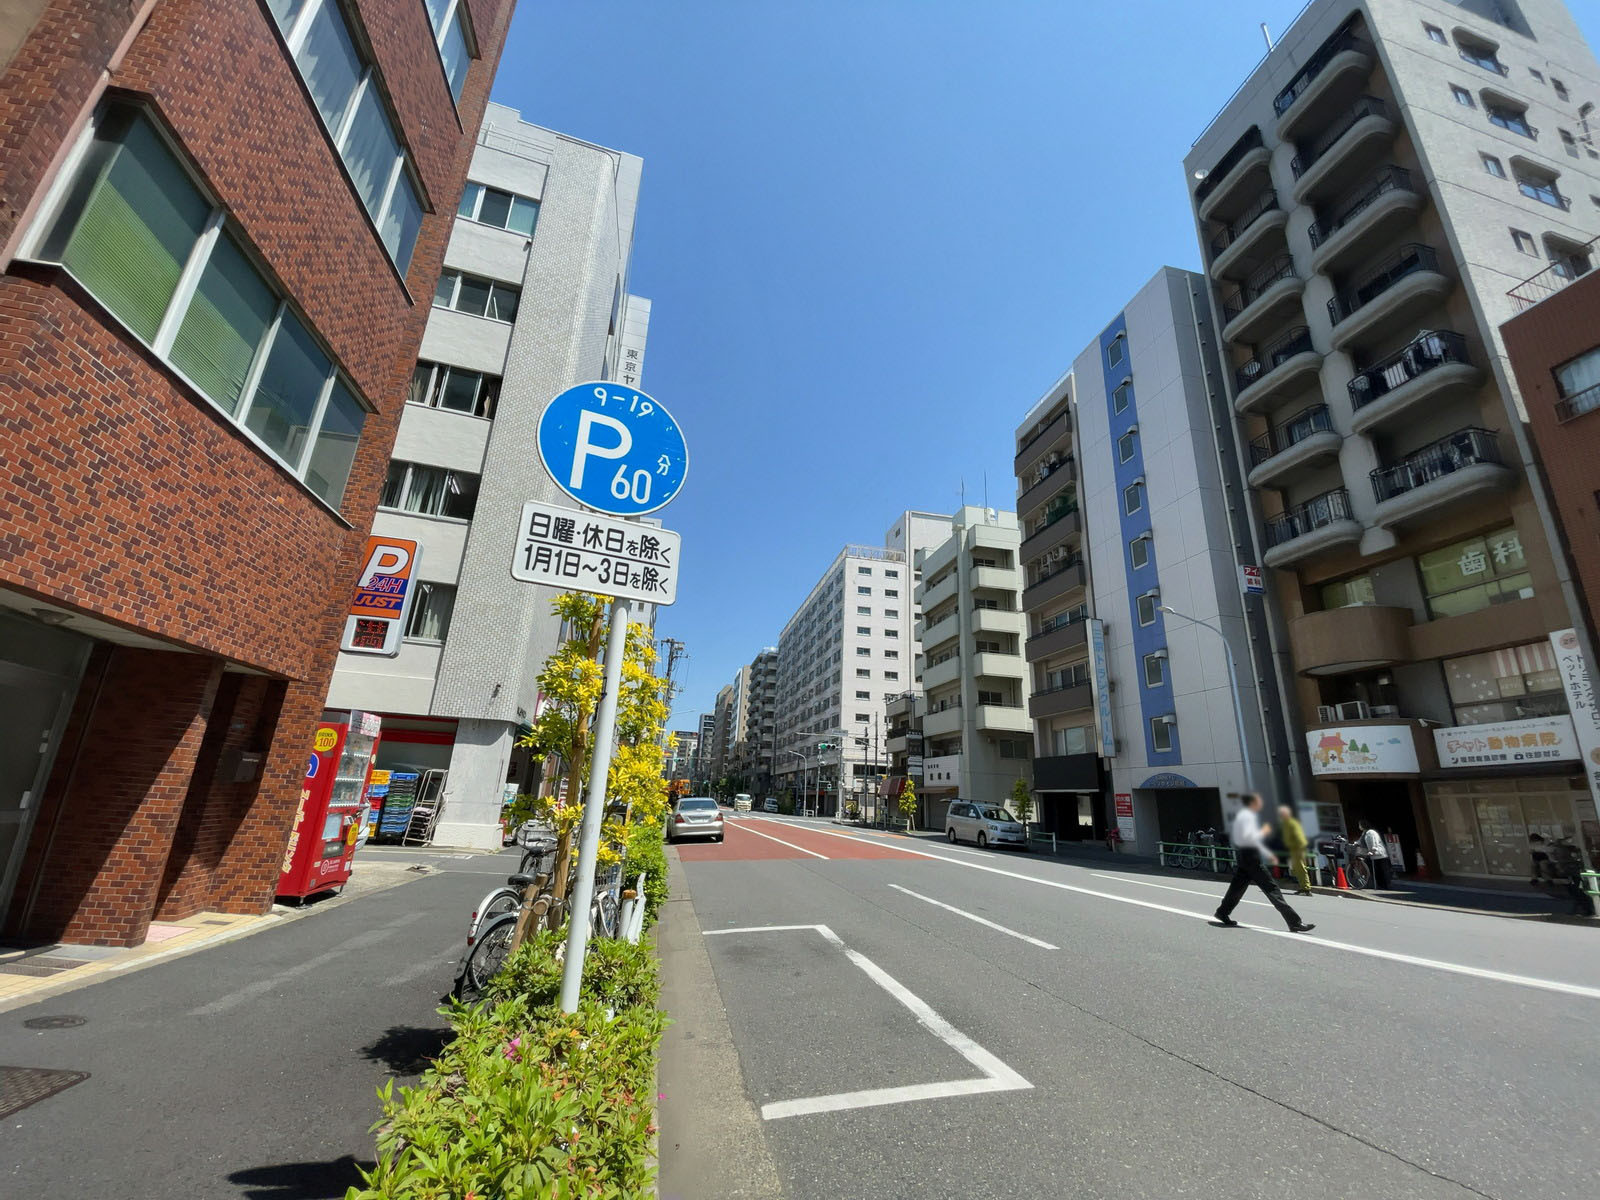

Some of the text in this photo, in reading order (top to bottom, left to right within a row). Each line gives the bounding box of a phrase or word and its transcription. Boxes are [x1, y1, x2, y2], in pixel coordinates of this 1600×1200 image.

[593, 387, 654, 417] 9-19
[569, 409, 633, 490] P
[611, 454, 671, 504] 60 分
[529, 512, 671, 564] 日曜・休日を除く
[1457, 536, 1524, 577] 歯科
[358, 544, 411, 588] P
[364, 576, 402, 593] 24H
[356, 594, 402, 609] JUST
[1562, 655, 1585, 709] ペットホテル
